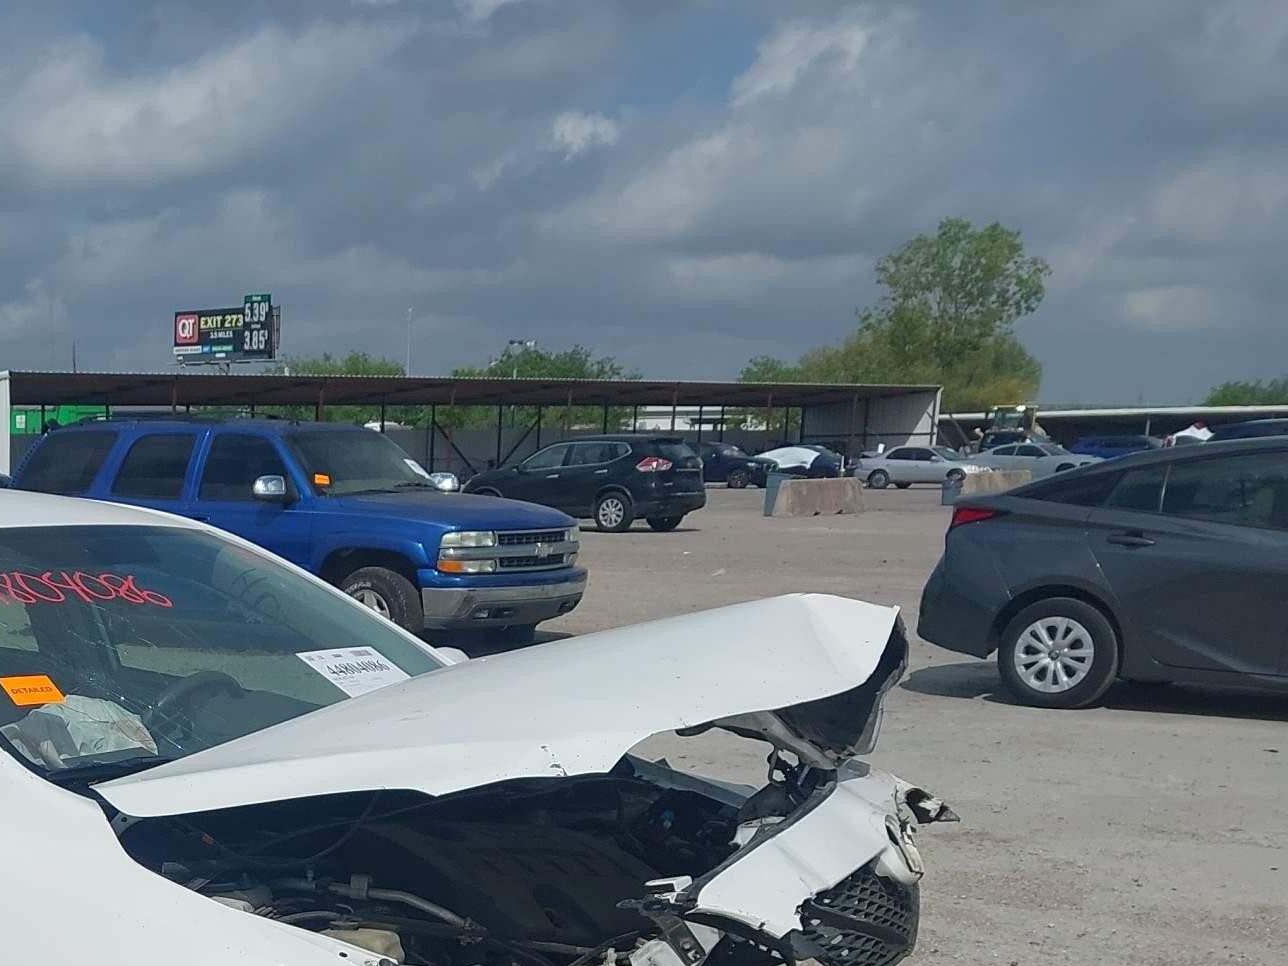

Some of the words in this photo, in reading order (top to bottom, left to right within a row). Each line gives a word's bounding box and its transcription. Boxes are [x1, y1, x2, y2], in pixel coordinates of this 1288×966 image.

[179, 319, 195, 338] QT
[200, 316, 222, 329] EXIT
[224, 314, 244, 328] 273
[11, 686, 53, 695] DETAILED
